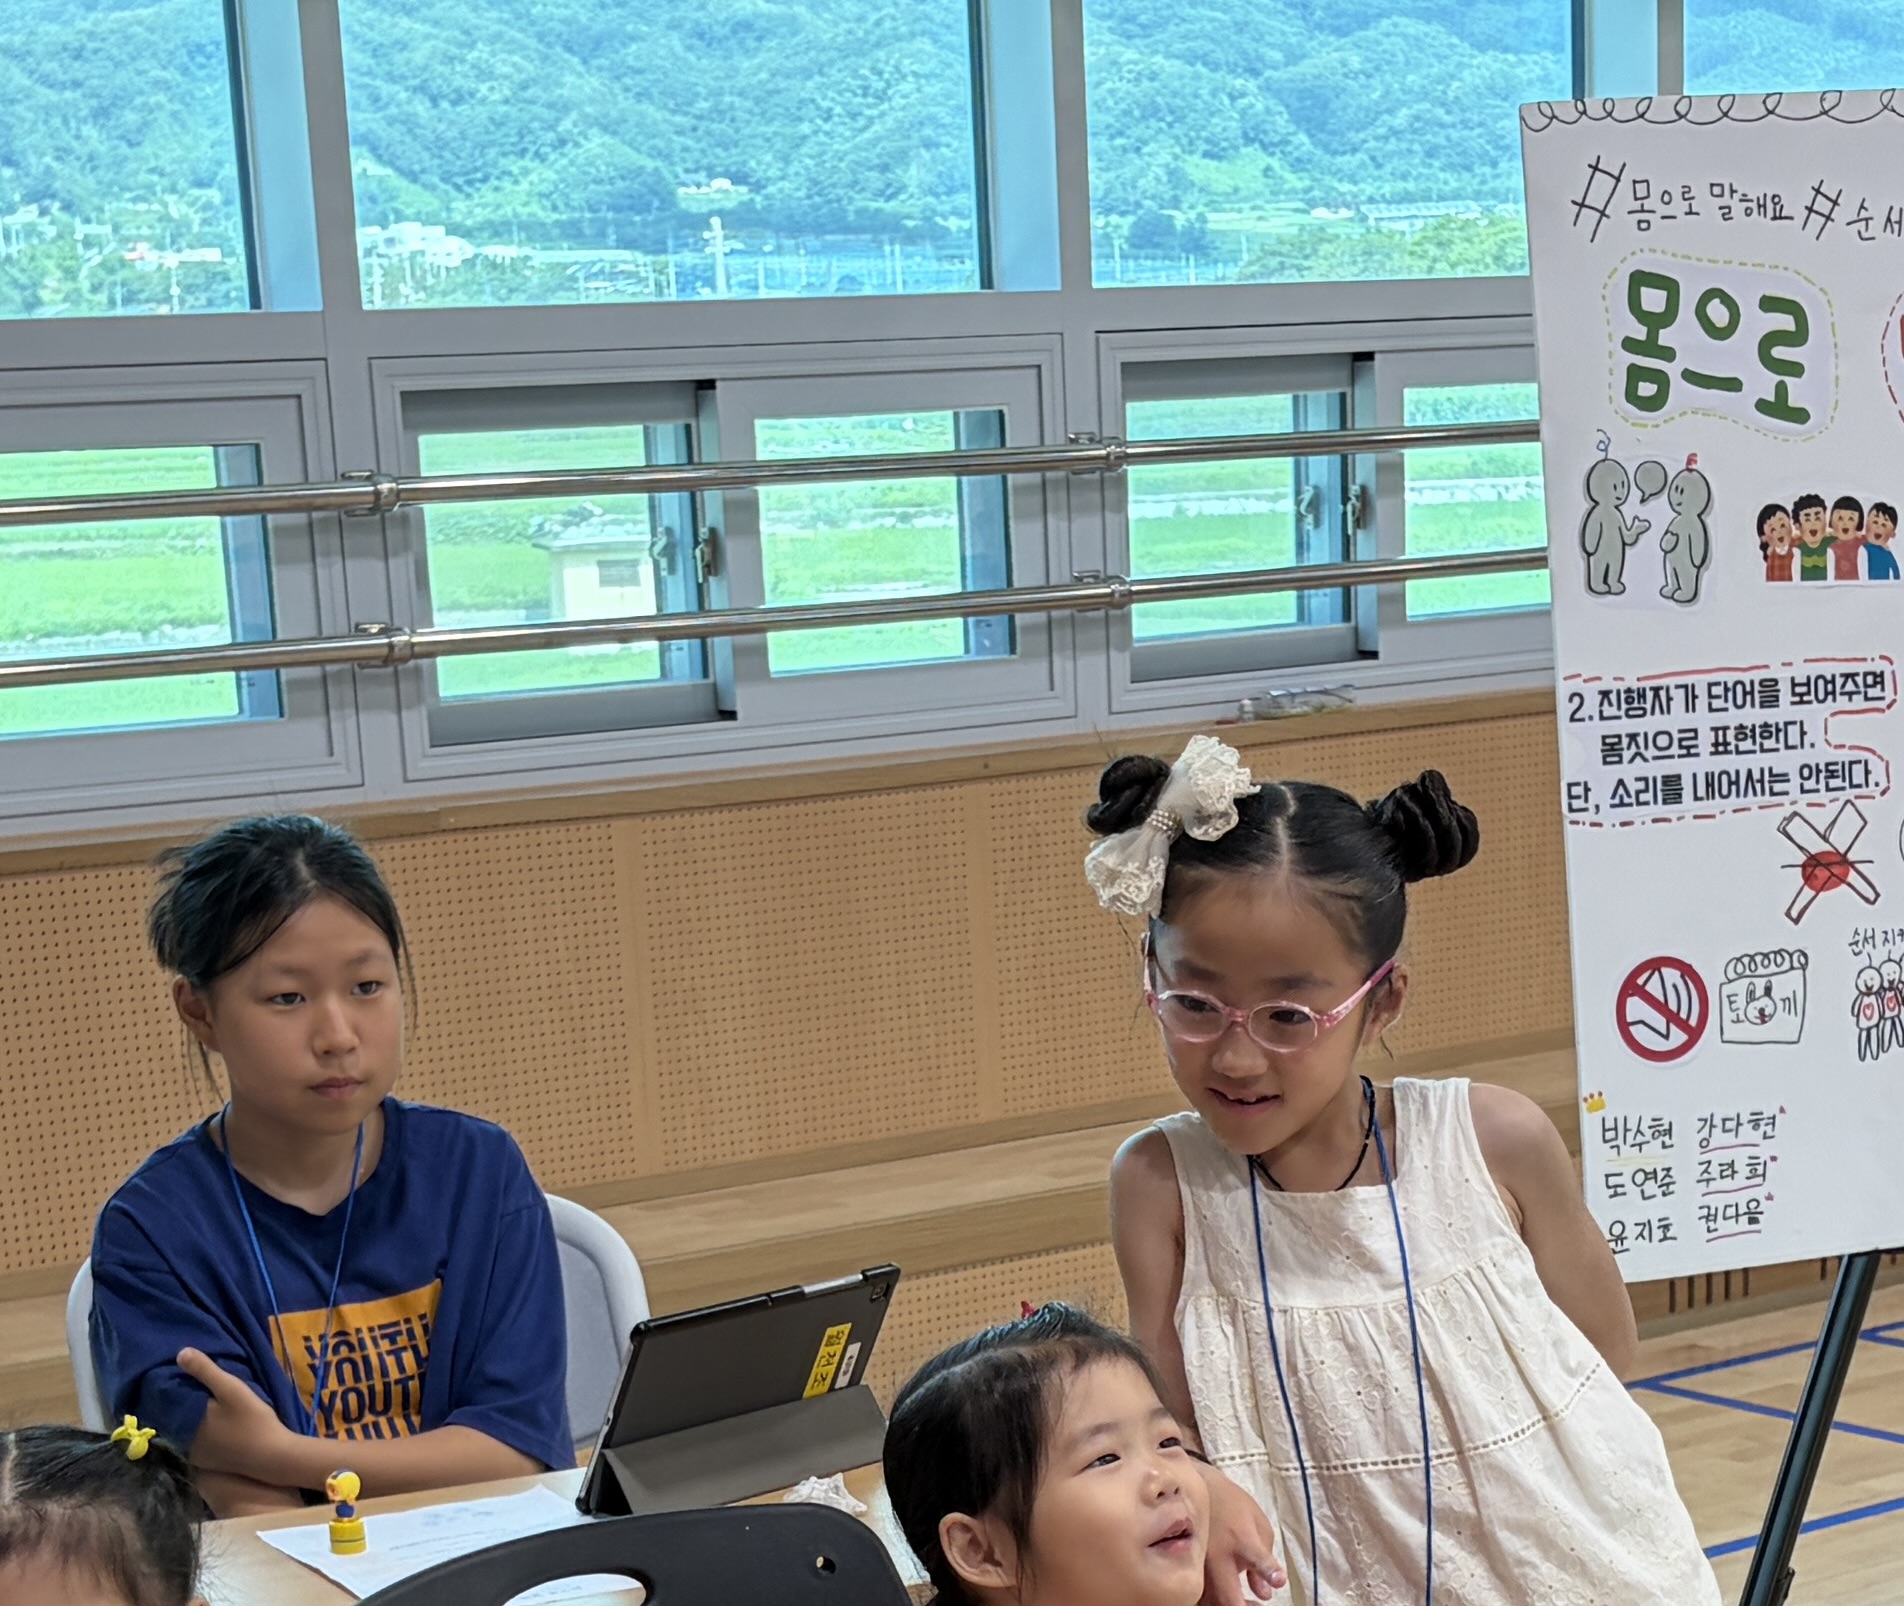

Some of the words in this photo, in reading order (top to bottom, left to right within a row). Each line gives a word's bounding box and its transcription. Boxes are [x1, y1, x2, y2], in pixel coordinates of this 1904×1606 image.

[1710, 182, 1795, 222] 말해요
[1621, 269, 1811, 425] 몸으로
[1706, 677, 1781, 713] 단어을
[1789, 669, 1886, 707] 보여주면
[1600, 727, 1700, 766] 몸짓으로
[1708, 719, 1815, 757] 표현한다.
[1566, 780, 1601, 815] 단,
[1608, 773, 1684, 808] 소리를
[1692, 766, 1790, 802] 내어서는
[1798, 759, 1881, 795] 안된다.
[1848, 927, 1877, 957] 순서
[1601, 1114, 1675, 1157] 박수현
[1696, 1110, 1777, 1149] 강다현
